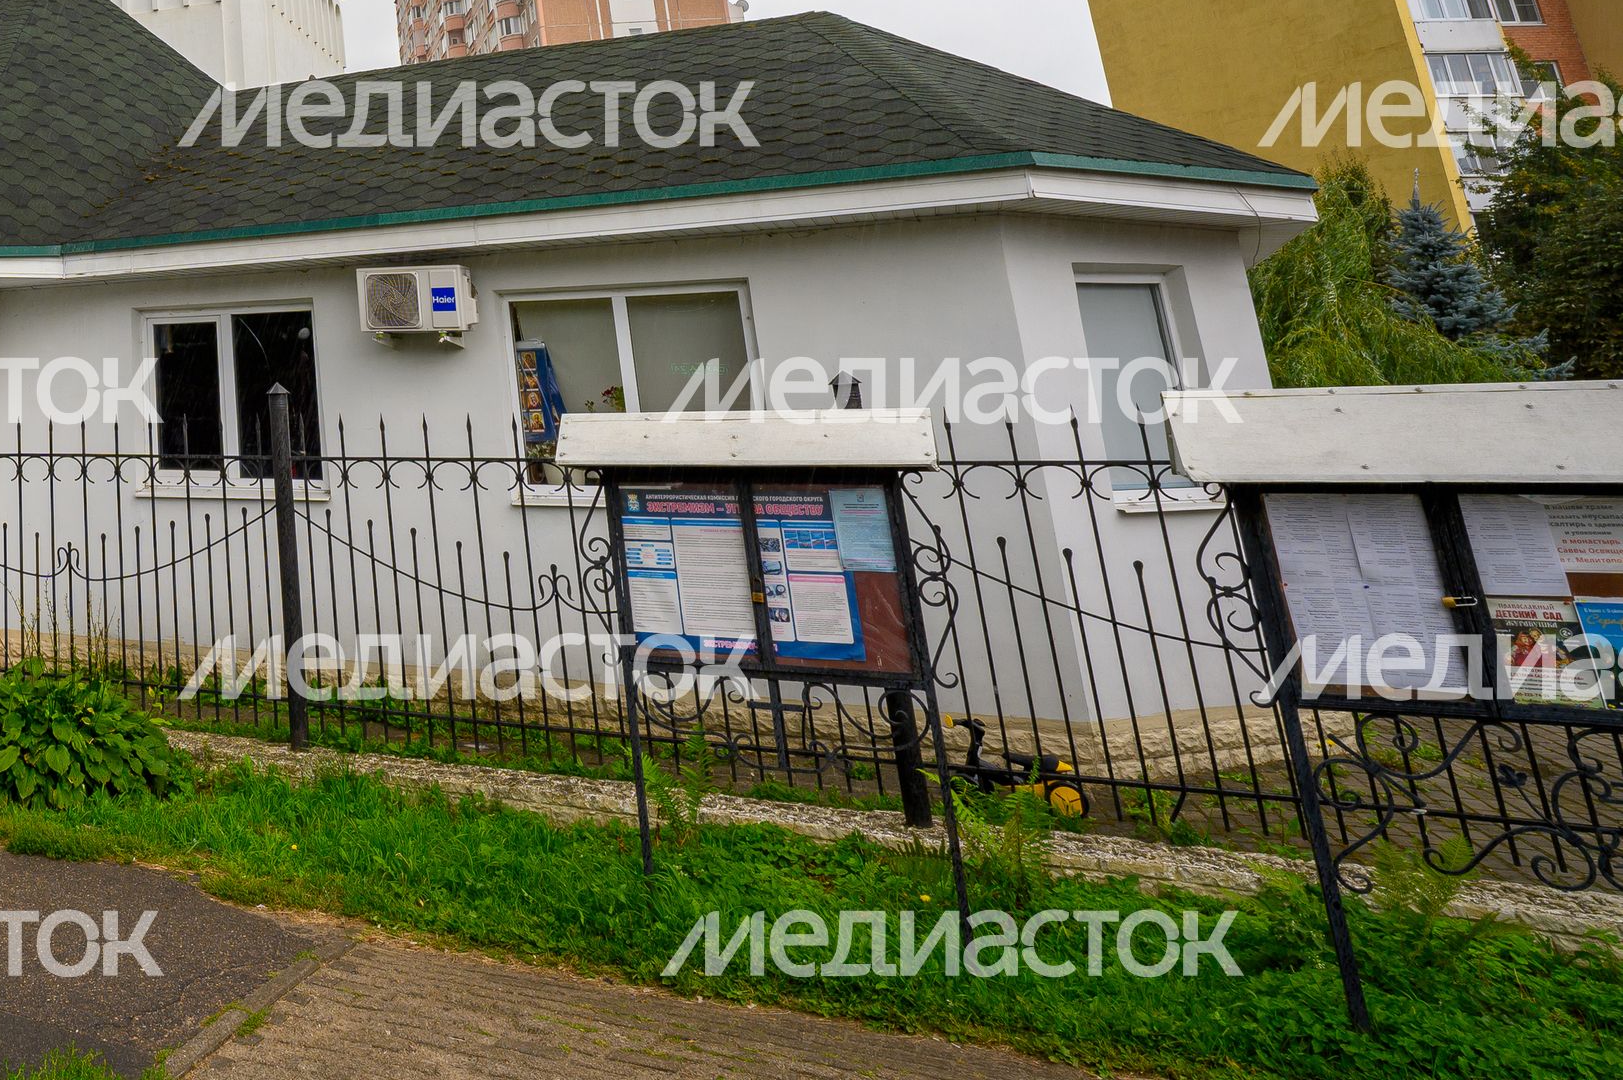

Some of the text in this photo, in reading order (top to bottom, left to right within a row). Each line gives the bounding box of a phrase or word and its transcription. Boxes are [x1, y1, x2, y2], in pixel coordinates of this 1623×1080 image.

[432, 295, 455, 304] Haier
[646, 502, 715, 514] ЭКСТРЕМИЗМ
[765, 504, 824, 517] ОБЩЕСТВУ
[1569, 538, 1621, 547] монастырь
[1495, 610, 1564, 621] ДЕТСКИЙ САД
